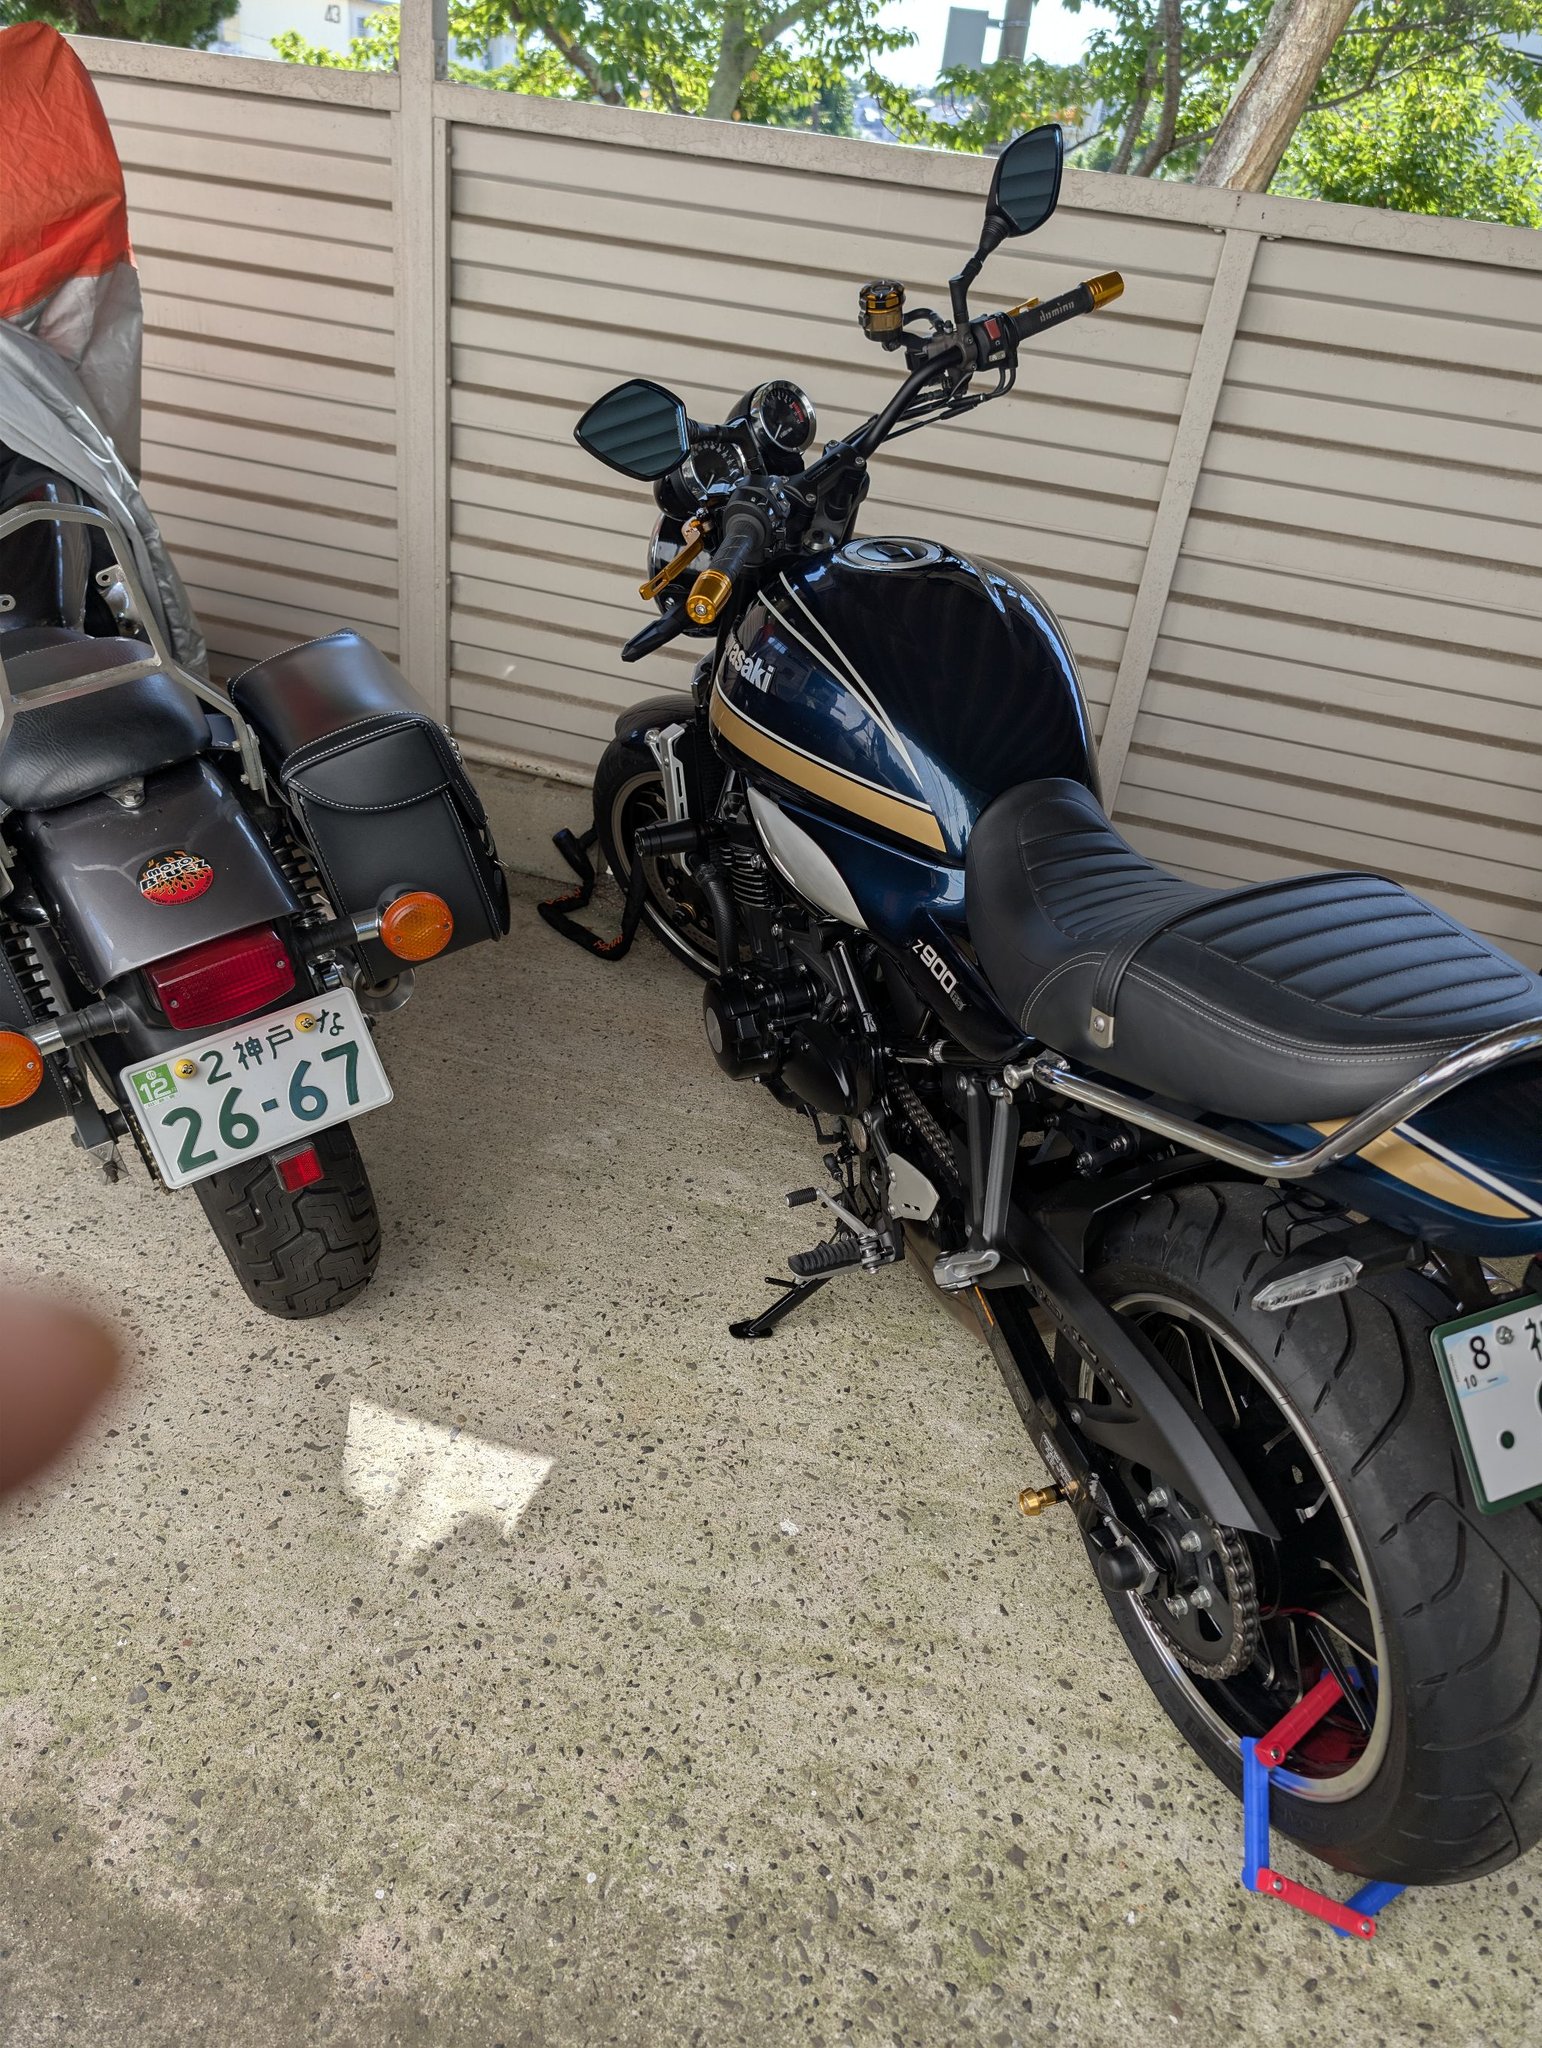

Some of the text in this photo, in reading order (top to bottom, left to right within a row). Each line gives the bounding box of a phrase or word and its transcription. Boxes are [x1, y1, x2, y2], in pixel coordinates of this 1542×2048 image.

[324, 4, 341, 24] 43
[147, 857, 193, 878] MOTO
[140, 1077, 171, 1102] 12
[161, 1040, 361, 1174] 26-67
[1470, 1335, 1491, 1370] 8
[1464, 1374, 1478, 1390] 10
